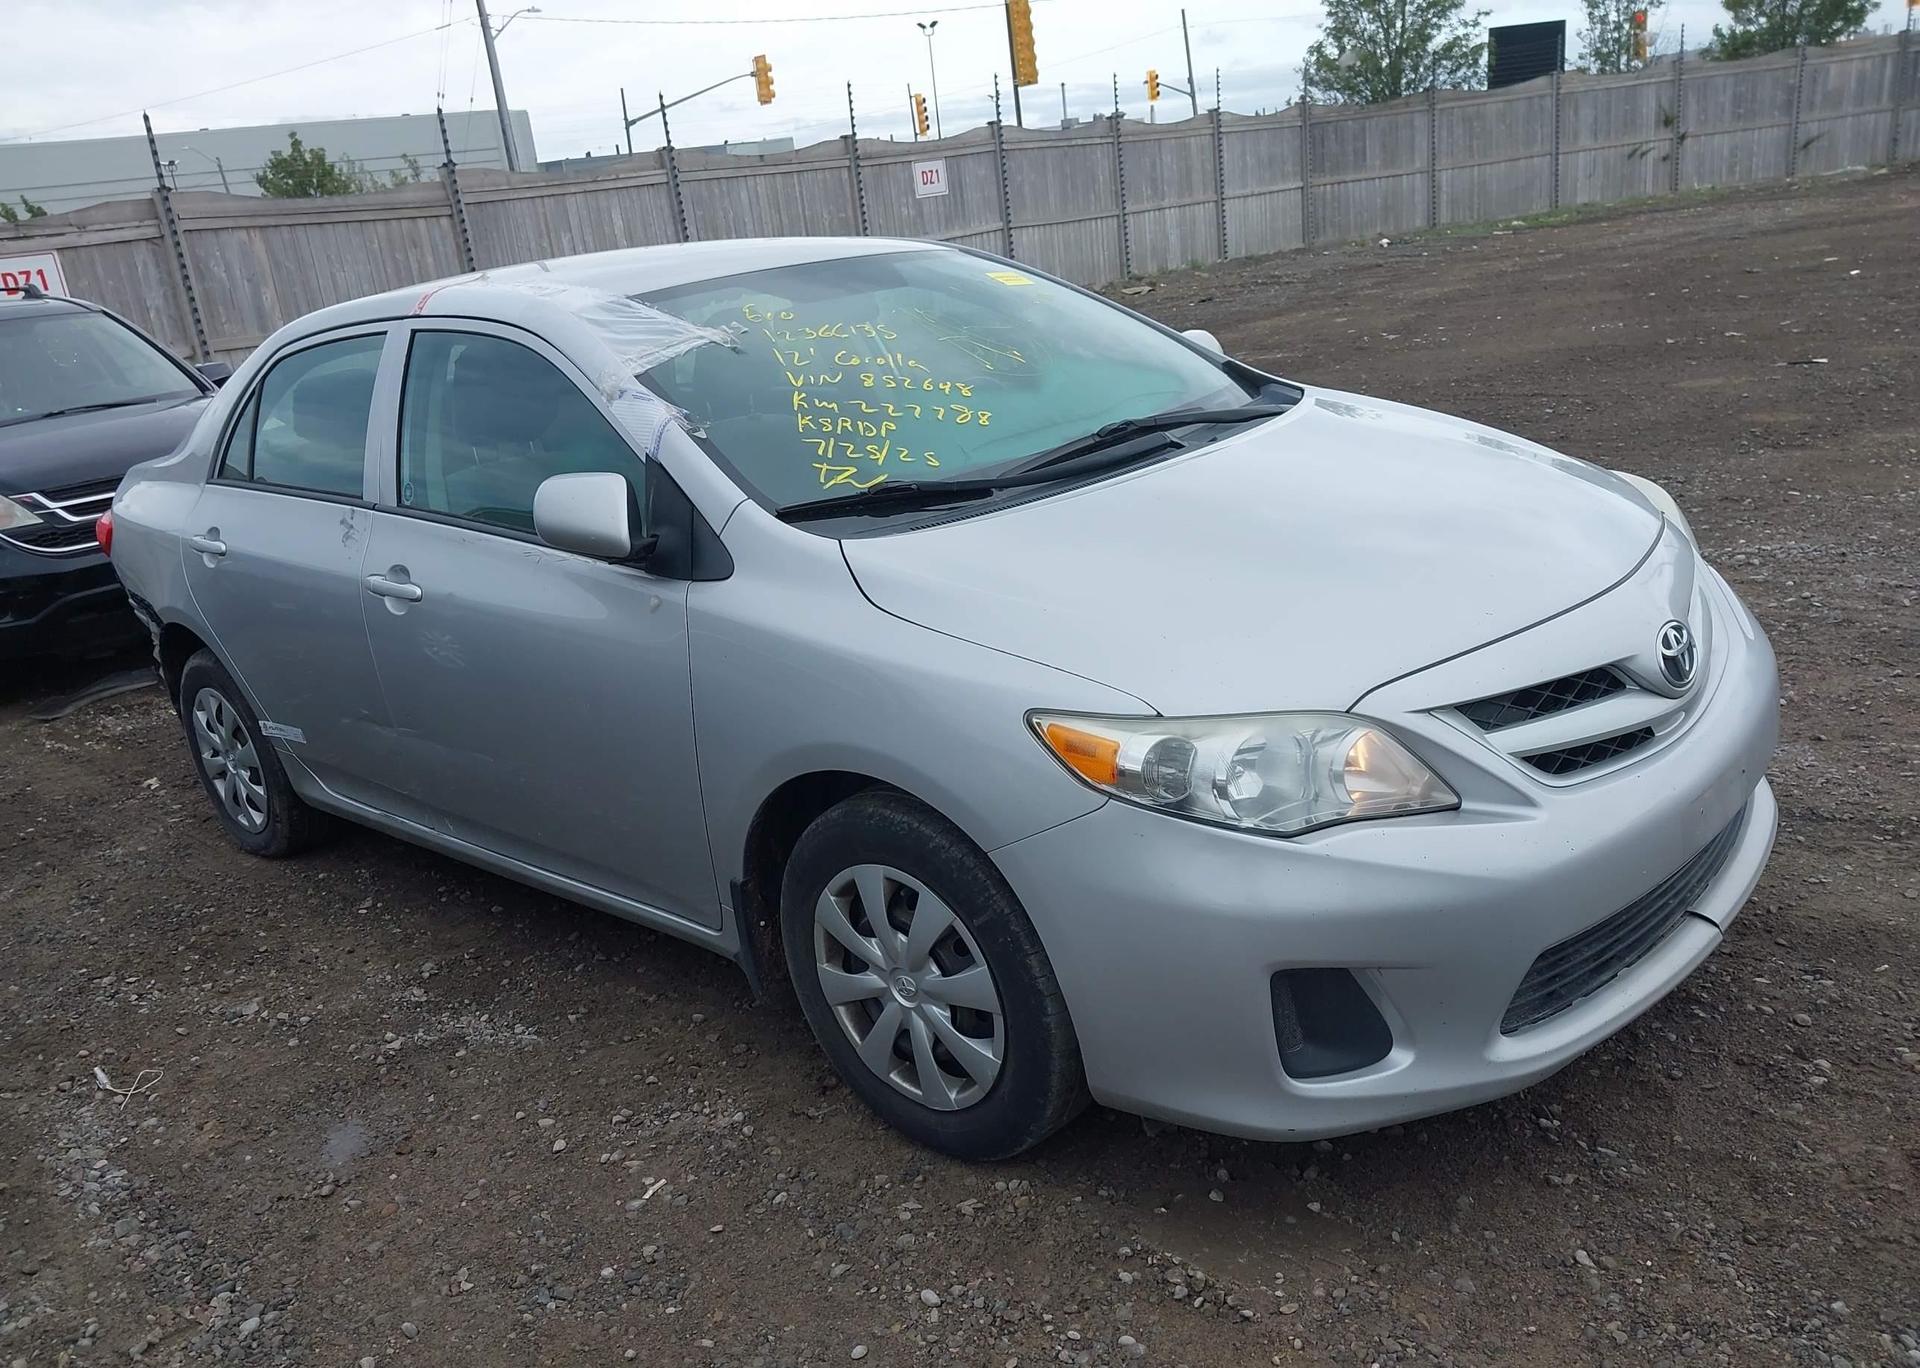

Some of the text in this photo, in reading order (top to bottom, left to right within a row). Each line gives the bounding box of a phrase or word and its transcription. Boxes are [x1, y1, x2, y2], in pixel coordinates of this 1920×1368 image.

[921, 168, 941, 186] DZ1
[834, 350, 930, 372] Corolla
[786, 371, 975, 397] VIN 852648
